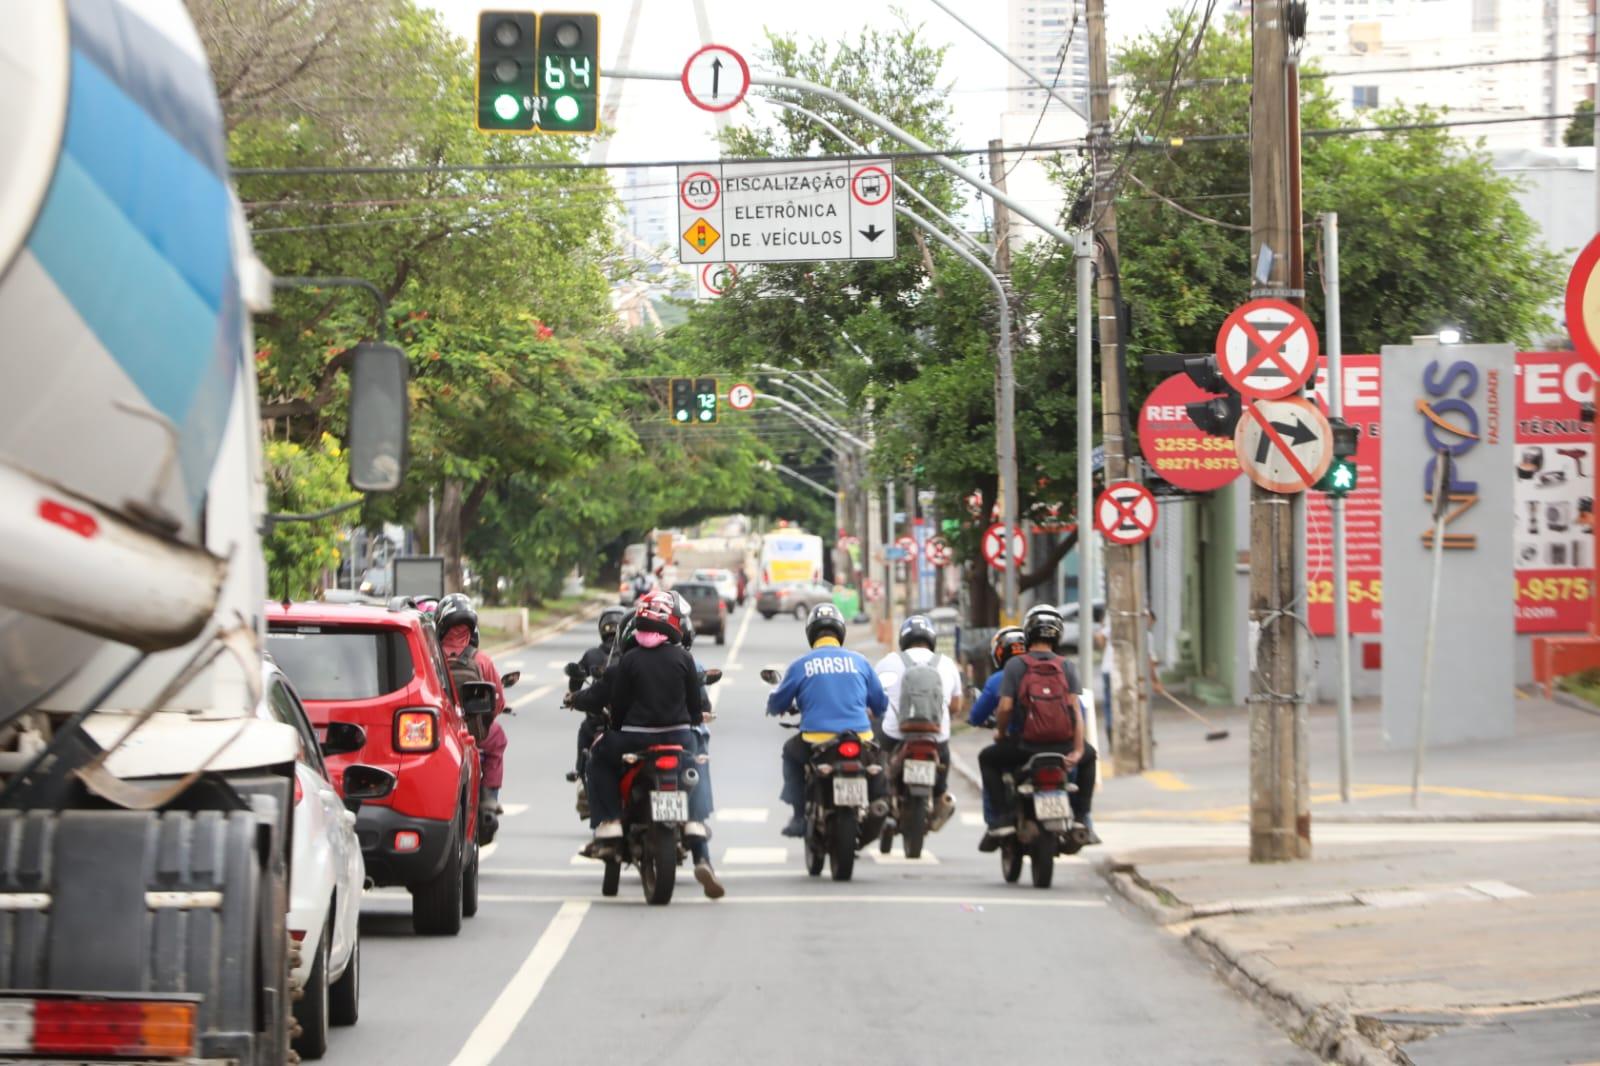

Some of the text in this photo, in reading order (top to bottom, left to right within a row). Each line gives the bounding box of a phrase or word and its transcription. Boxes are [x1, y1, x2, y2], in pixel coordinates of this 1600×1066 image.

[545, 55, 590, 90] 64
[688, 180, 712, 196] 60
[726, 171, 846, 193] FISCALIZAÇÃO
[735, 200, 837, 220] ELETRÔNICA
[730, 227, 843, 247] DE VEÍCULOS
[1154, 437, 1234, 451] 3255-554
[804, 656, 858, 678] BRASIL
